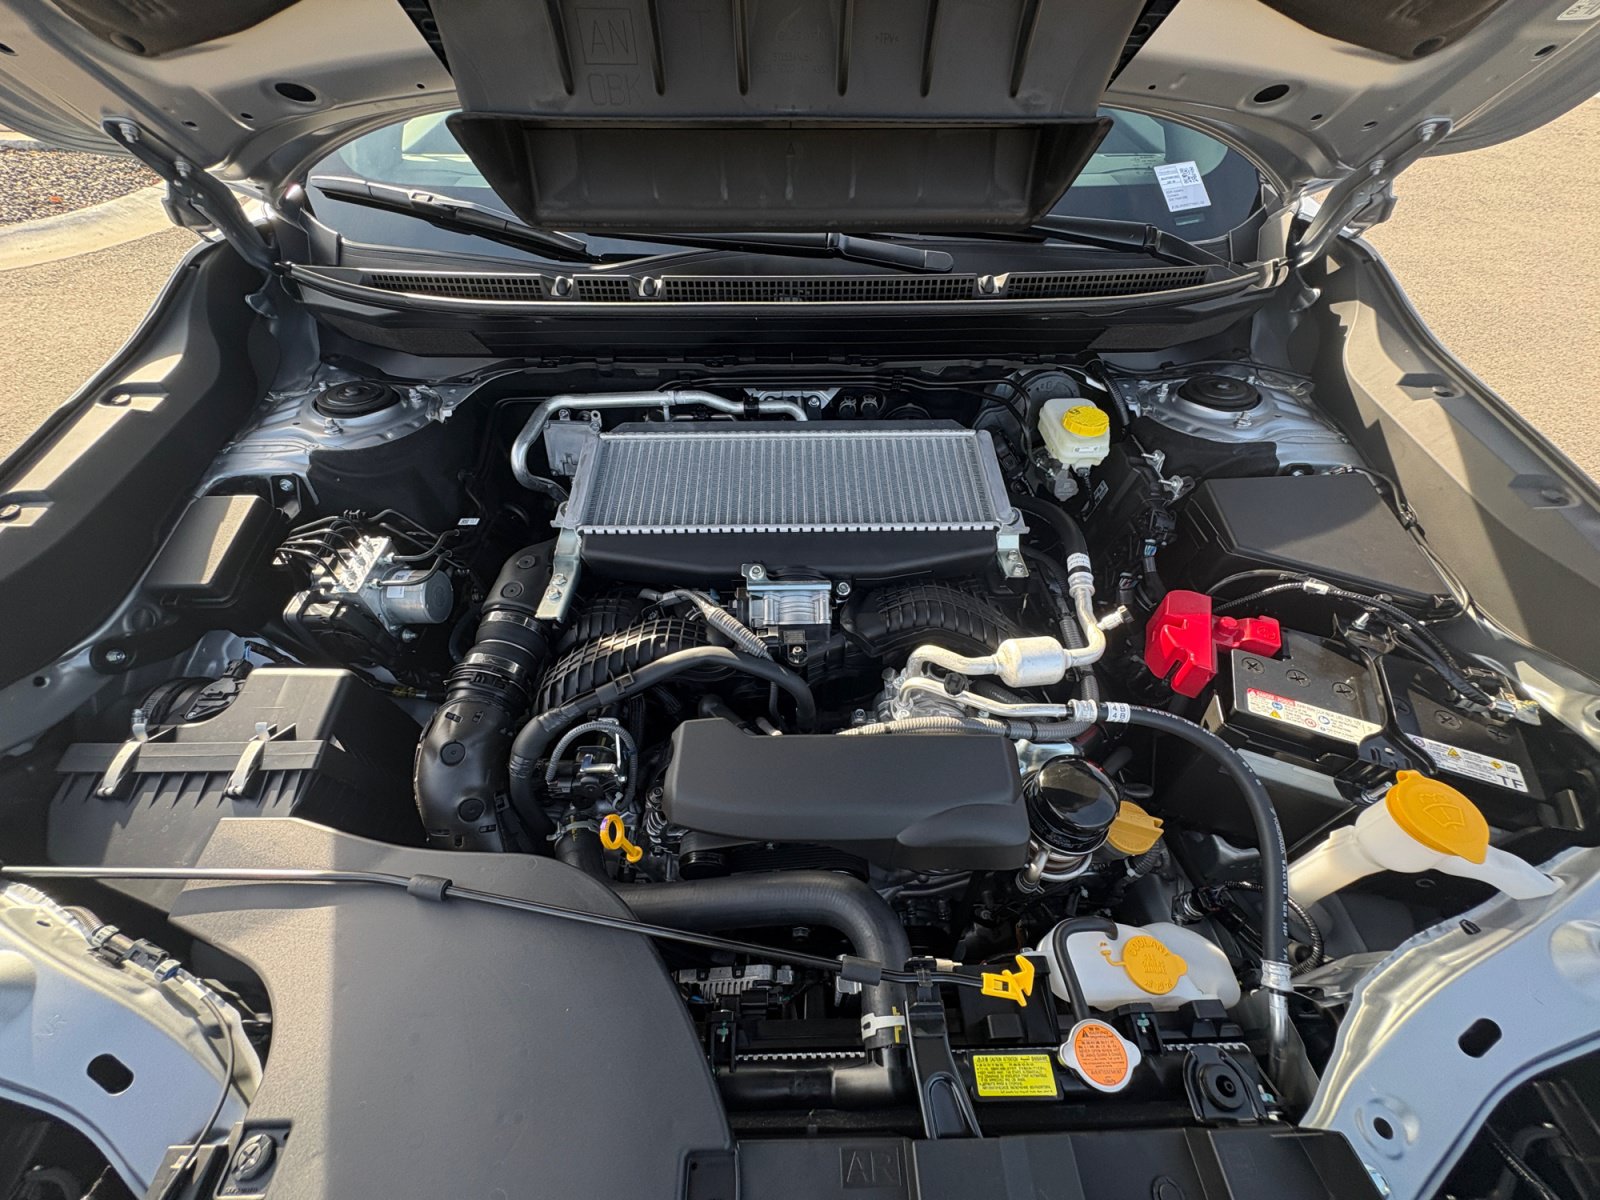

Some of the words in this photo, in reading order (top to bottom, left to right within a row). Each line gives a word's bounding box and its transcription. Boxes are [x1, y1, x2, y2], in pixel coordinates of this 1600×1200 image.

[590, 18, 630, 57] AN
[1496, 774, 1525, 790] TF
[1127, 937, 1170, 957] COOLANT
[846, 1151, 894, 1183] AR
